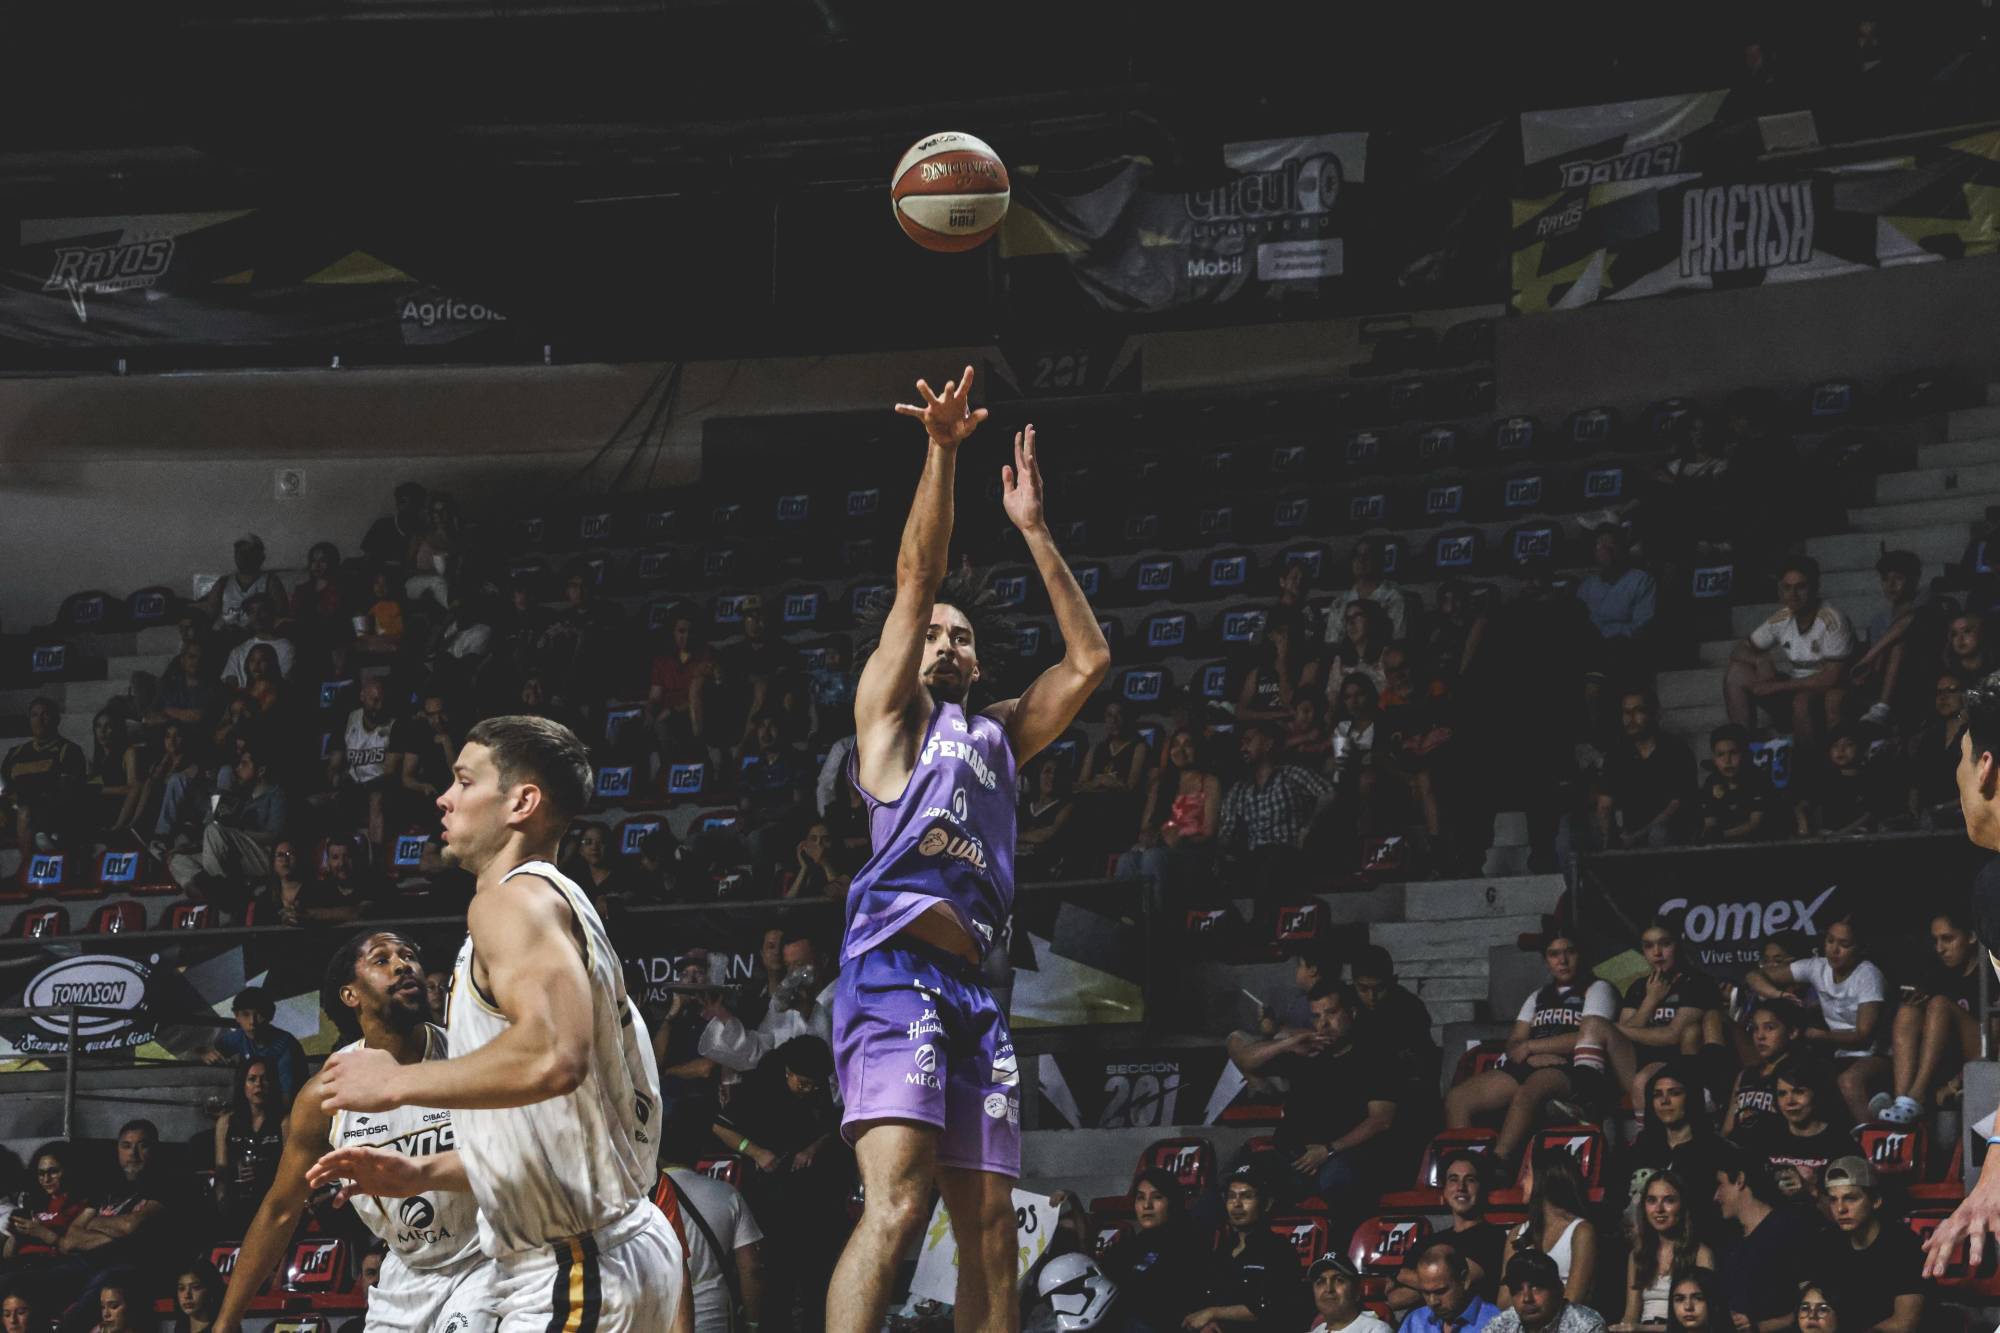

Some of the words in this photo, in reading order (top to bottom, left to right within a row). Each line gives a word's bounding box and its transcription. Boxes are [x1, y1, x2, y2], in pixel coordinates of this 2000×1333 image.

[55, 240, 170, 284] RAYOS
[1187, 255, 1243, 276] Mobil
[1216, 562, 1240, 580] 021
[1152, 622, 1182, 641] 025
[1128, 678, 1158, 695] 030
[601, 772, 629, 791] 024
[672, 769, 700, 787] 025
[34, 857, 58, 877] 016
[106, 855, 131, 876] 017
[1701, 950, 1733, 965] Vive
[1737, 949, 1760, 963] tus
[53, 981, 126, 1004] TOMASON
[905, 1072, 942, 1091] MEGA
[1098, 1074, 1182, 1127] 201
[398, 1227, 451, 1244] MEGA
